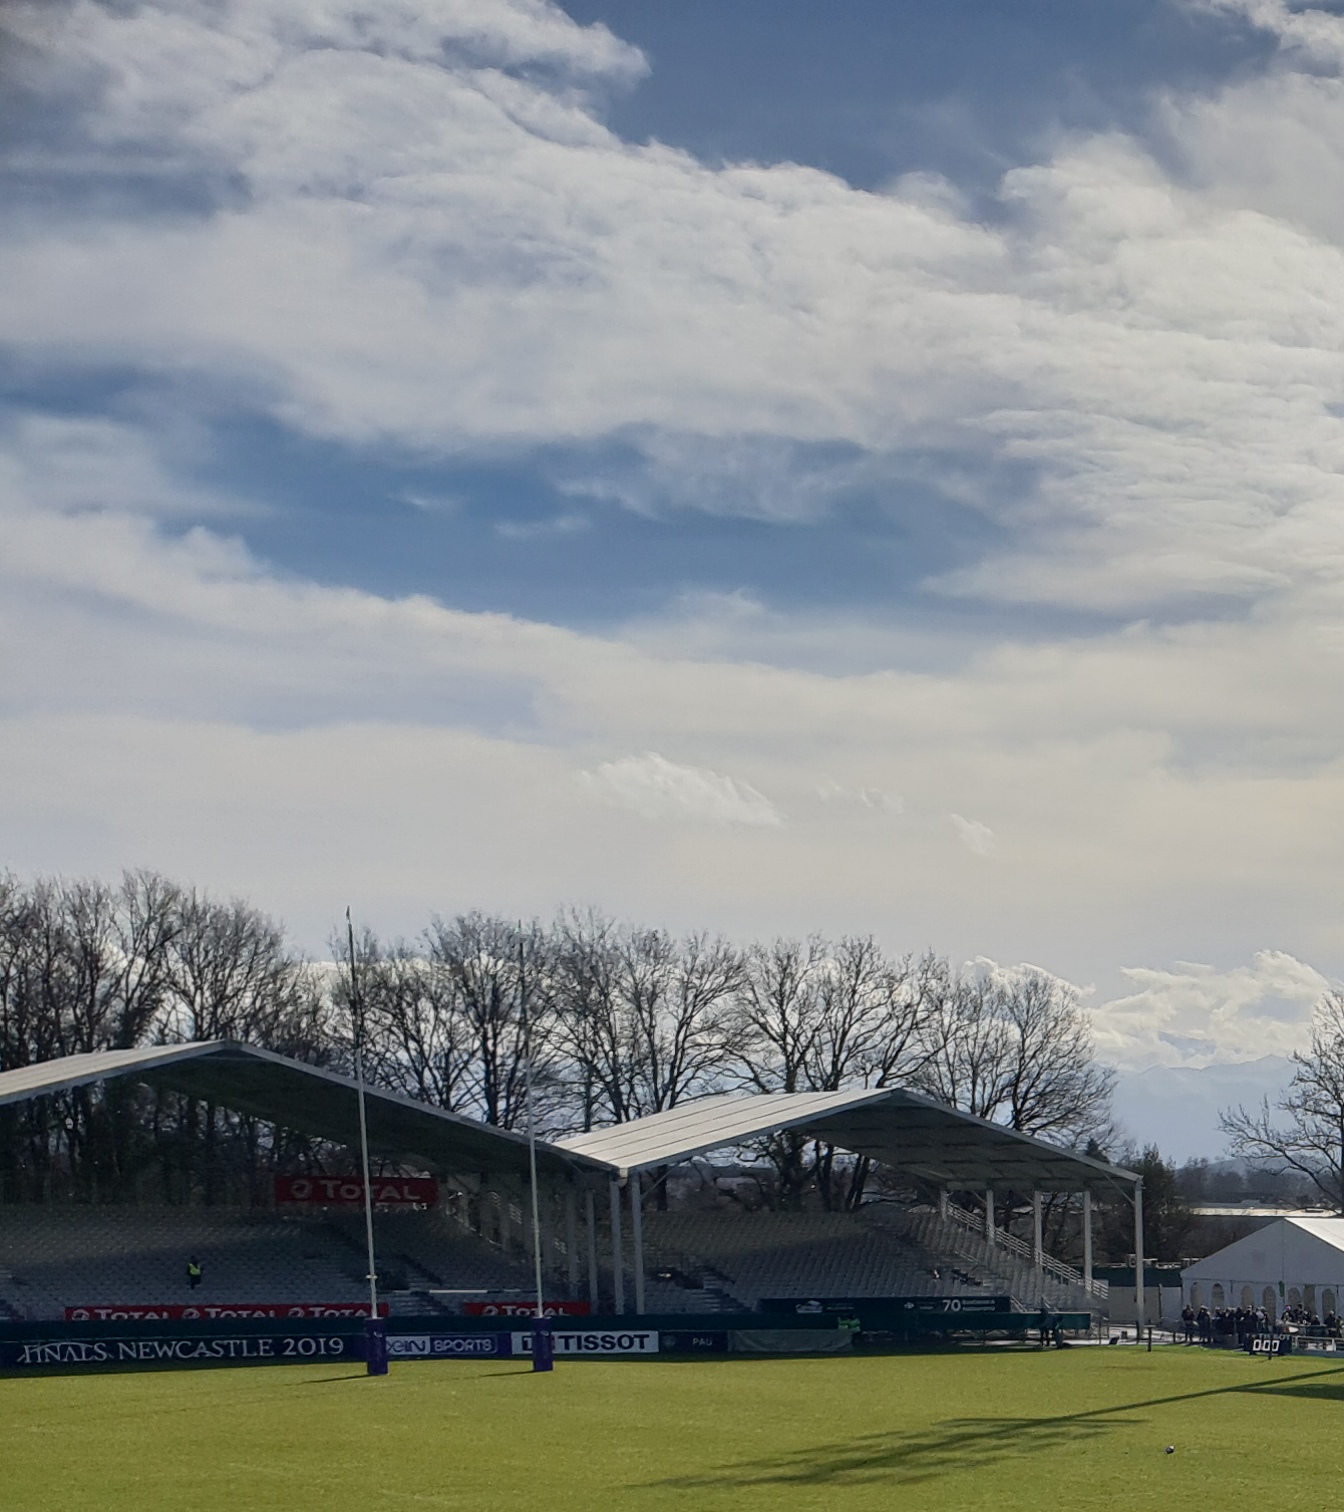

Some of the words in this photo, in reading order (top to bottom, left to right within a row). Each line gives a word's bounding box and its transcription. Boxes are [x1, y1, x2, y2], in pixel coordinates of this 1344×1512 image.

[308, 1306, 370, 1318] TOTA
[942, 1298, 962, 1312] 70
[117, 1338, 275, 1361] NEWCASTLE
[283, 1336, 345, 1357] 2019
[434, 1338, 493, 1352] SPORTS
[558, 1334, 650, 1351] TISSOT
